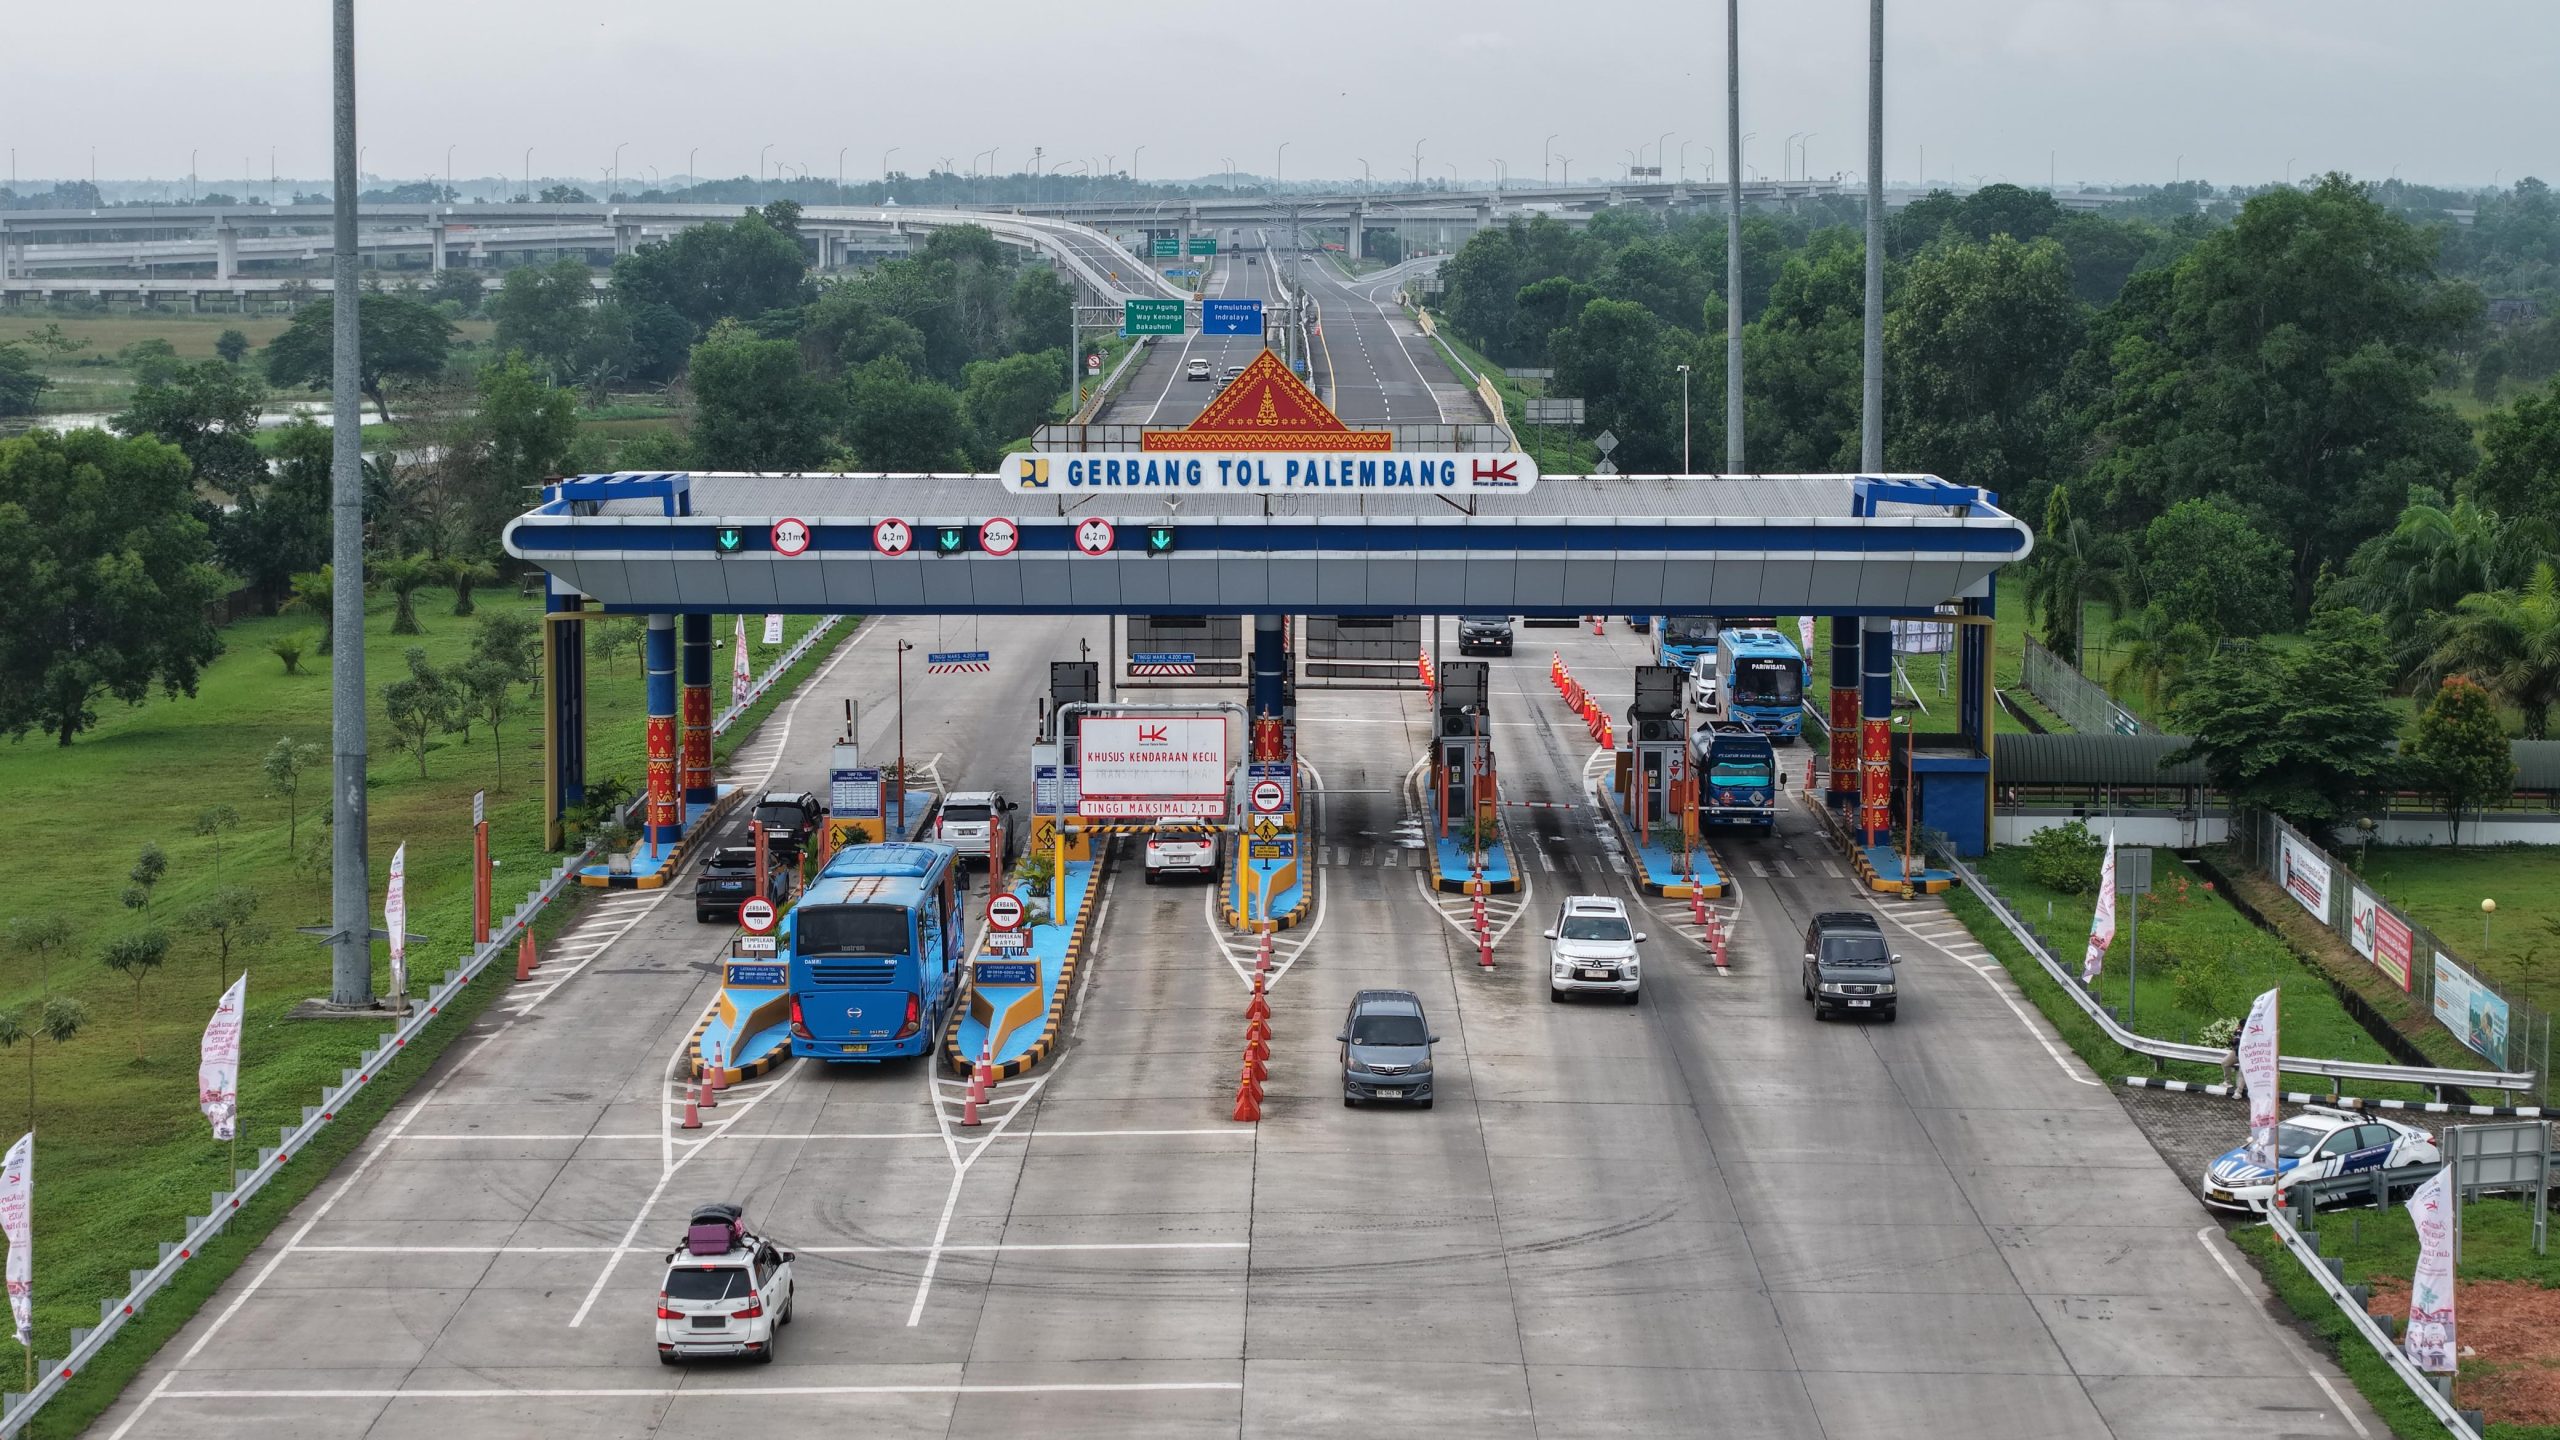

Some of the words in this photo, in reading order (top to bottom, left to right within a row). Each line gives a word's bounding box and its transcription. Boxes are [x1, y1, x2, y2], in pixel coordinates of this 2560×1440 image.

[1156, 304, 1178, 312] Agung
[1068, 459, 1202, 487] GERBANG
[1218, 459, 1271, 487] TOL
[1286, 459, 1456, 487] PALEMBANG
[1139, 724, 1167, 742] HK
[1087, 752, 1125, 762] KHUSUS
[1129, 752, 1188, 762] KENDARAAN
[1192, 752, 1218, 762] KECIL
[1087, 803, 1123, 813] TINGGI
[1129, 803, 1185, 813] MAKSIMAL
[1191, 803, 1204, 815] 2,1
[1208, 804, 1217, 813] m
